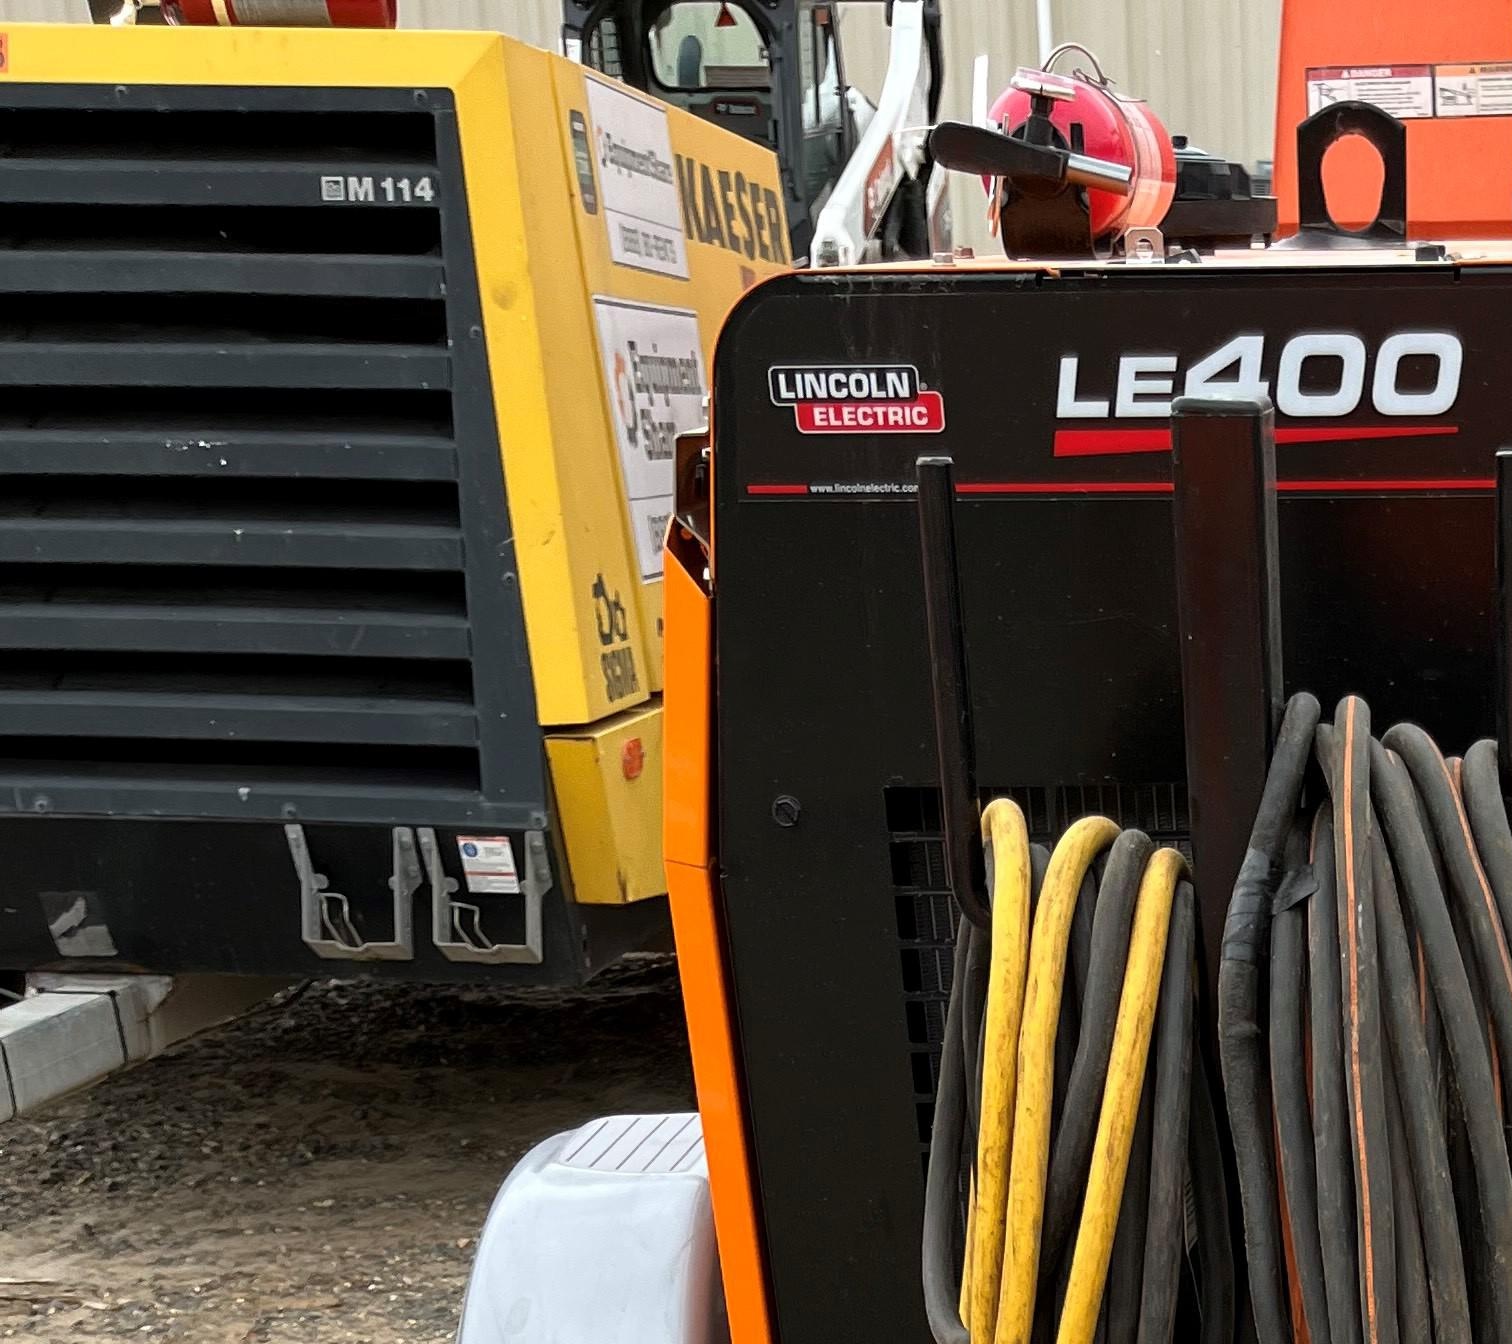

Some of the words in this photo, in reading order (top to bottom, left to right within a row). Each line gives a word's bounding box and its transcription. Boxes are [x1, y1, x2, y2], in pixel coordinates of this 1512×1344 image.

[347, 176, 375, 202] M
[381, 176, 435, 202] 114
[674, 153, 788, 265] KAESER
[627, 340, 701, 407] Equipment
[778, 372, 911, 400] LINCOLN
[1056, 332, 1464, 418] LE400
[812, 406, 929, 426] ELECTRIC
